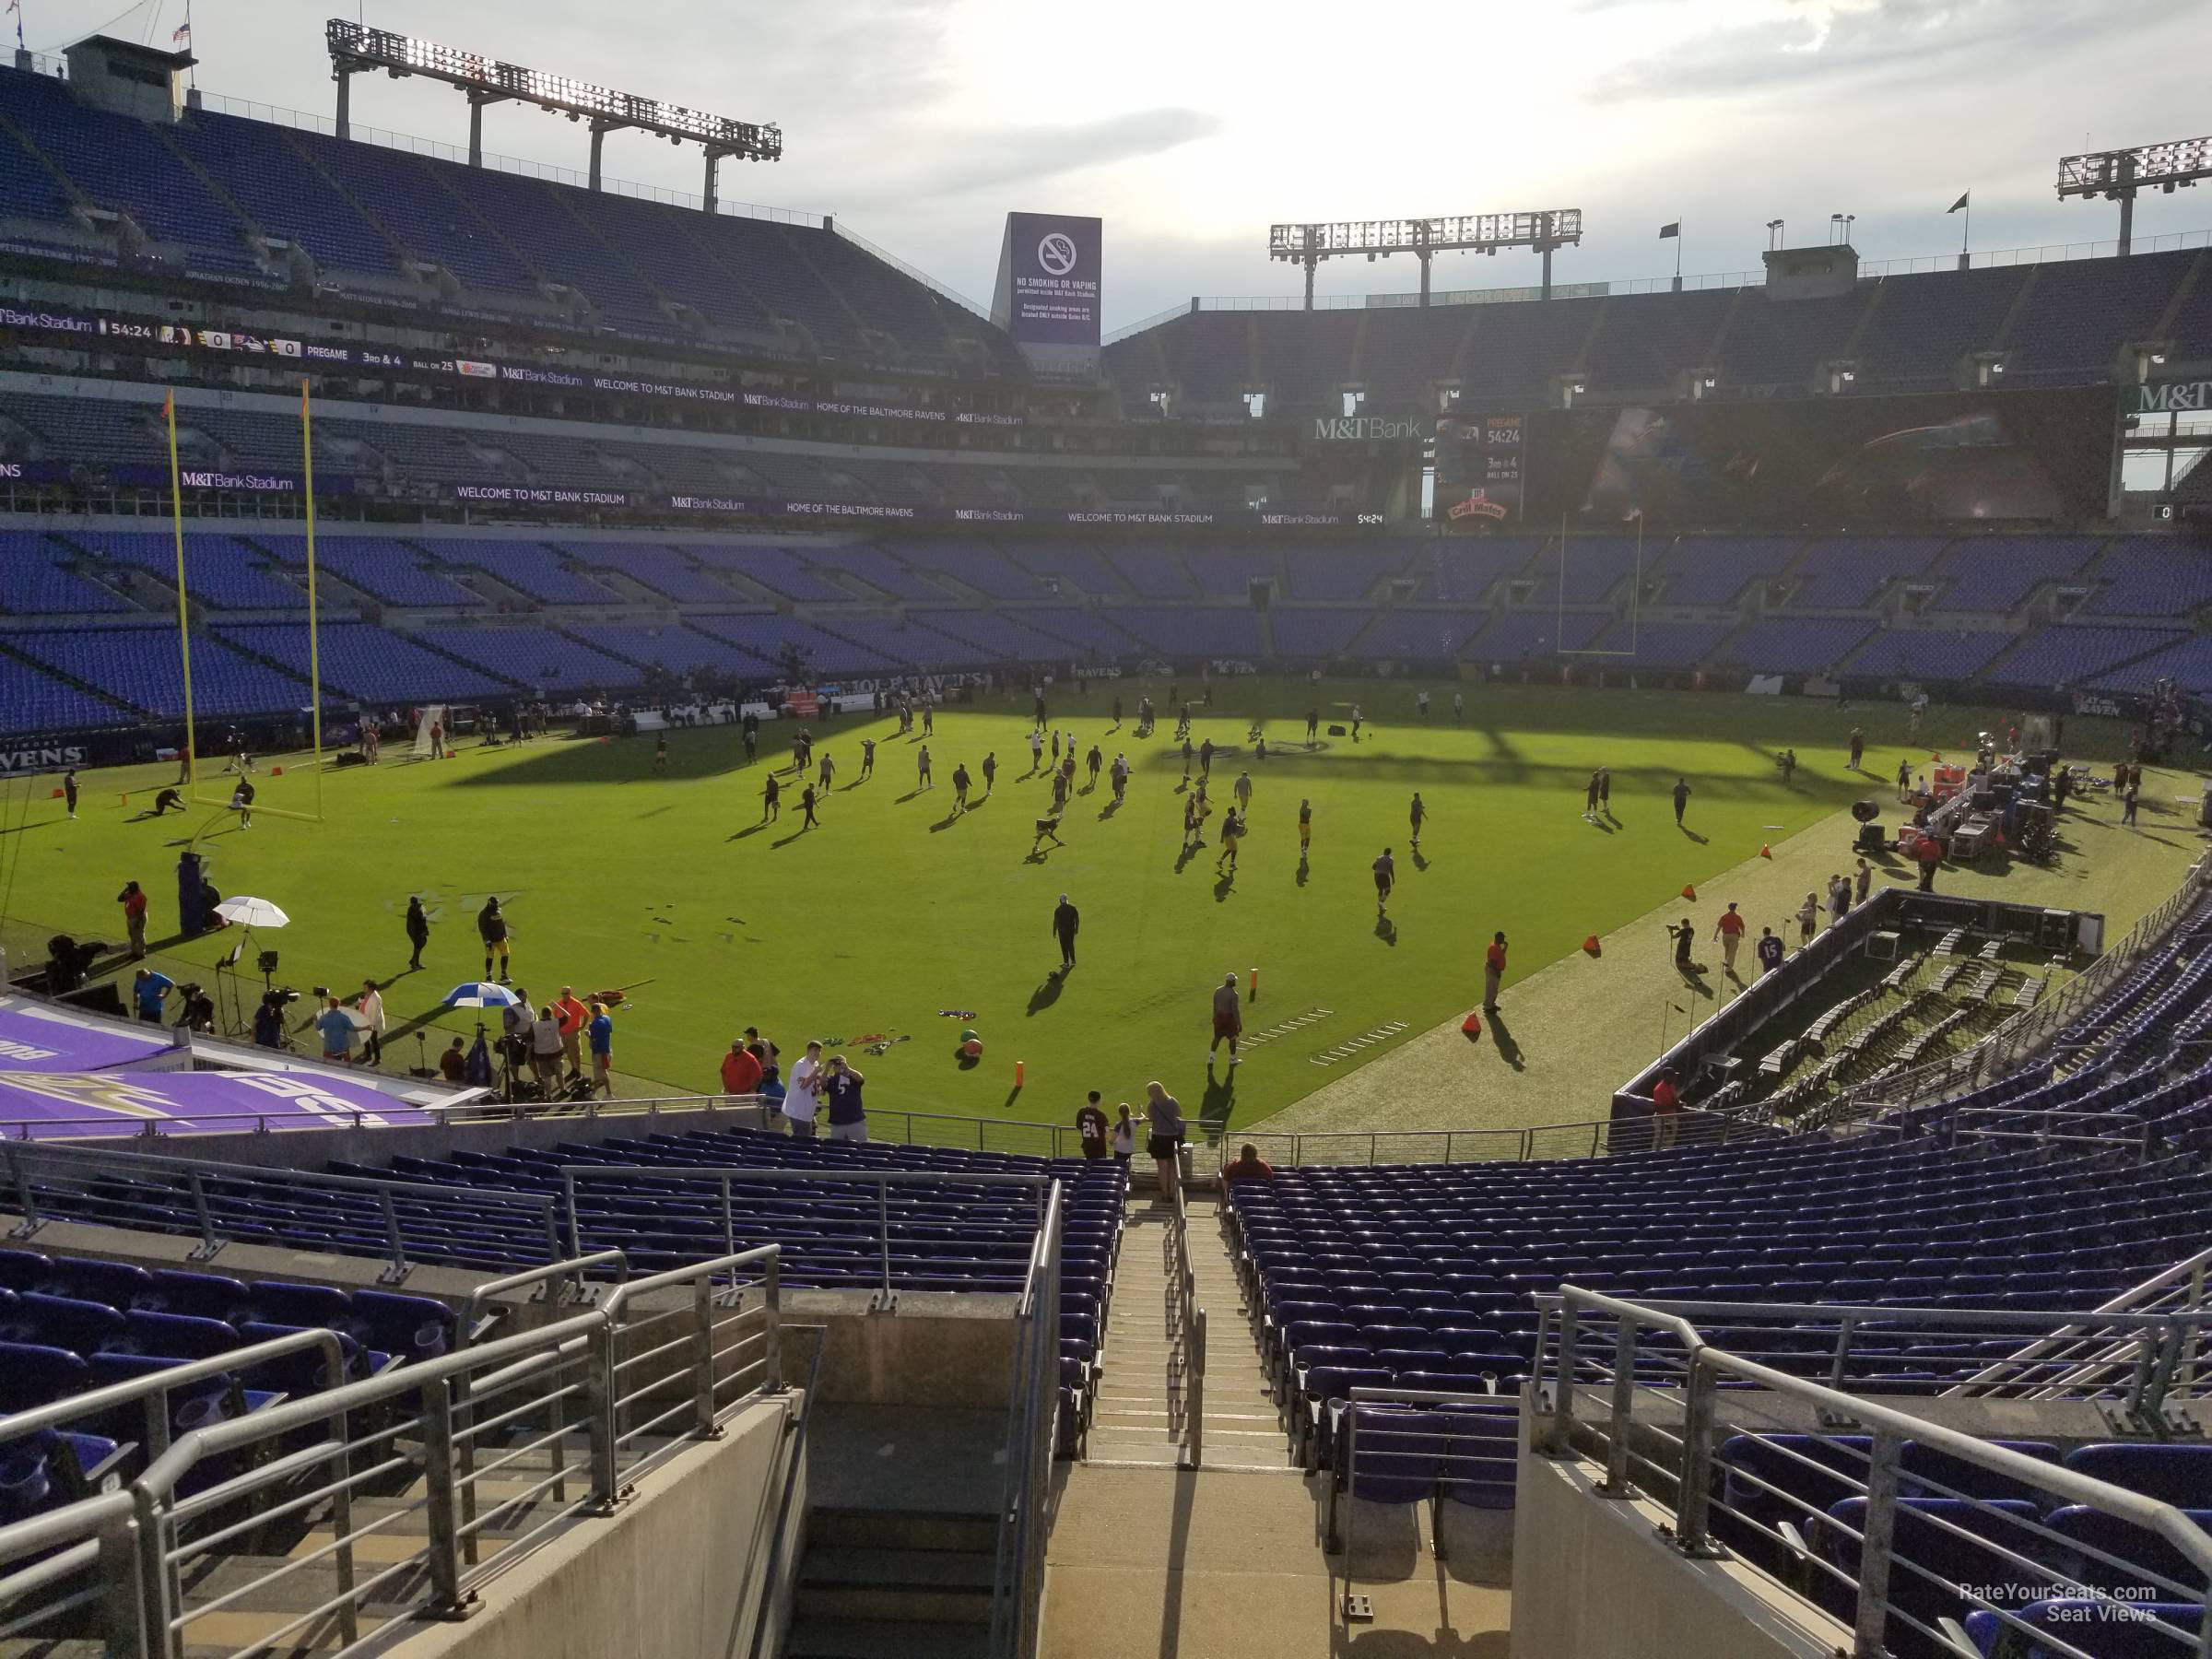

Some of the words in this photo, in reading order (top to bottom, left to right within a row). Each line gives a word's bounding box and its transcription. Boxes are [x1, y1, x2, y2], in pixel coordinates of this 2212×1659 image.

[1018, 277, 1027, 287] NO
[1029, 278, 1059, 288] SMOKING
[1061, 280, 1070, 289] OR
[1072, 281, 1097, 290] VAPING
[6, 310, 39, 326] Bank
[40, 313, 92, 332] Stadium
[112, 323, 152, 338] 54:24
[214, 335, 223, 347] 0
[286, 343, 295, 356] 0
[307, 346, 347, 360] PREGAME
[382, 355, 391, 365] &
[394, 356, 402, 366] 4
[413, 360, 429, 370] BALL
[441, 360, 454, 371] 25
[502, 367, 526, 381] M&T
[525, 368, 549, 383] Bank
[549, 371, 583, 387] Stadium
[594, 378, 639, 393] WELCOME
[641, 382, 653, 394] TO
[654, 384, 674, 396] M&T
[675, 386, 699, 399] BANK
[700, 389, 735, 402] STADIUM
[2139, 382, 2212, 411] M&T
[744, 394, 762, 406] M&T
[762, 396, 782, 407] Bank
[781, 398, 809, 410] Stadium
[817, 402, 840, 413] HOME
[840, 404, 852, 415] OF
[853, 406, 869, 417] THE
[868, 407, 914, 420] BALTIMORE
[914, 410, 946, 421] RAVENS
[974, 414, 993, 424] Bank
[993, 415, 1023, 426] Stadium
[1314, 418, 1368, 440] M&T
[1370, 416, 1422, 439] Bank
[1487, 429, 1520, 443] 54:24
[182, 471, 215, 487] M&T
[216, 474, 244, 488] Bank
[245, 475, 293, 490] Stadium
[457, 486, 511, 500] WELCOME
[513, 489, 528, 500] TO
[531, 490, 552, 501] M&T
[555, 490, 581, 502] BANK
[582, 492, 625, 504] STADIUM
[672, 496, 693, 508] M&T
[693, 499, 713, 509] Bank
[712, 500, 745, 511] Stadium
[787, 502, 811, 512] HOME
[812, 503, 824, 512] OF
[825, 503, 841, 513] THE
[841, 505, 884, 516] BALTIMORE
[885, 507, 913, 517] RAVENS
[955, 509, 973, 520] M&T
[973, 511, 992, 521] Bank
[992, 511, 1024, 522] Stadium
[1068, 512, 1112, 523] WELCOME
[1113, 513, 1126, 523] TO
[1127, 513, 1147, 524] M&T
[1148, 513, 1173, 524] BANK
[1174, 513, 1213, 524] STADIUM
[1262, 514, 1283, 524] M&T
[1283, 514, 1305, 524] Bank
[1305, 514, 1339, 524] Stadium
[1358, 514, 1383, 524] 54:24
[2161, 507, 2171, 518] 0
[1076, 665, 1122, 678] RAVENS
[0, 747, 83, 771] VENS
[1764, 944, 1778, 959] 15
[1082, 1121, 1100, 1138] 24
